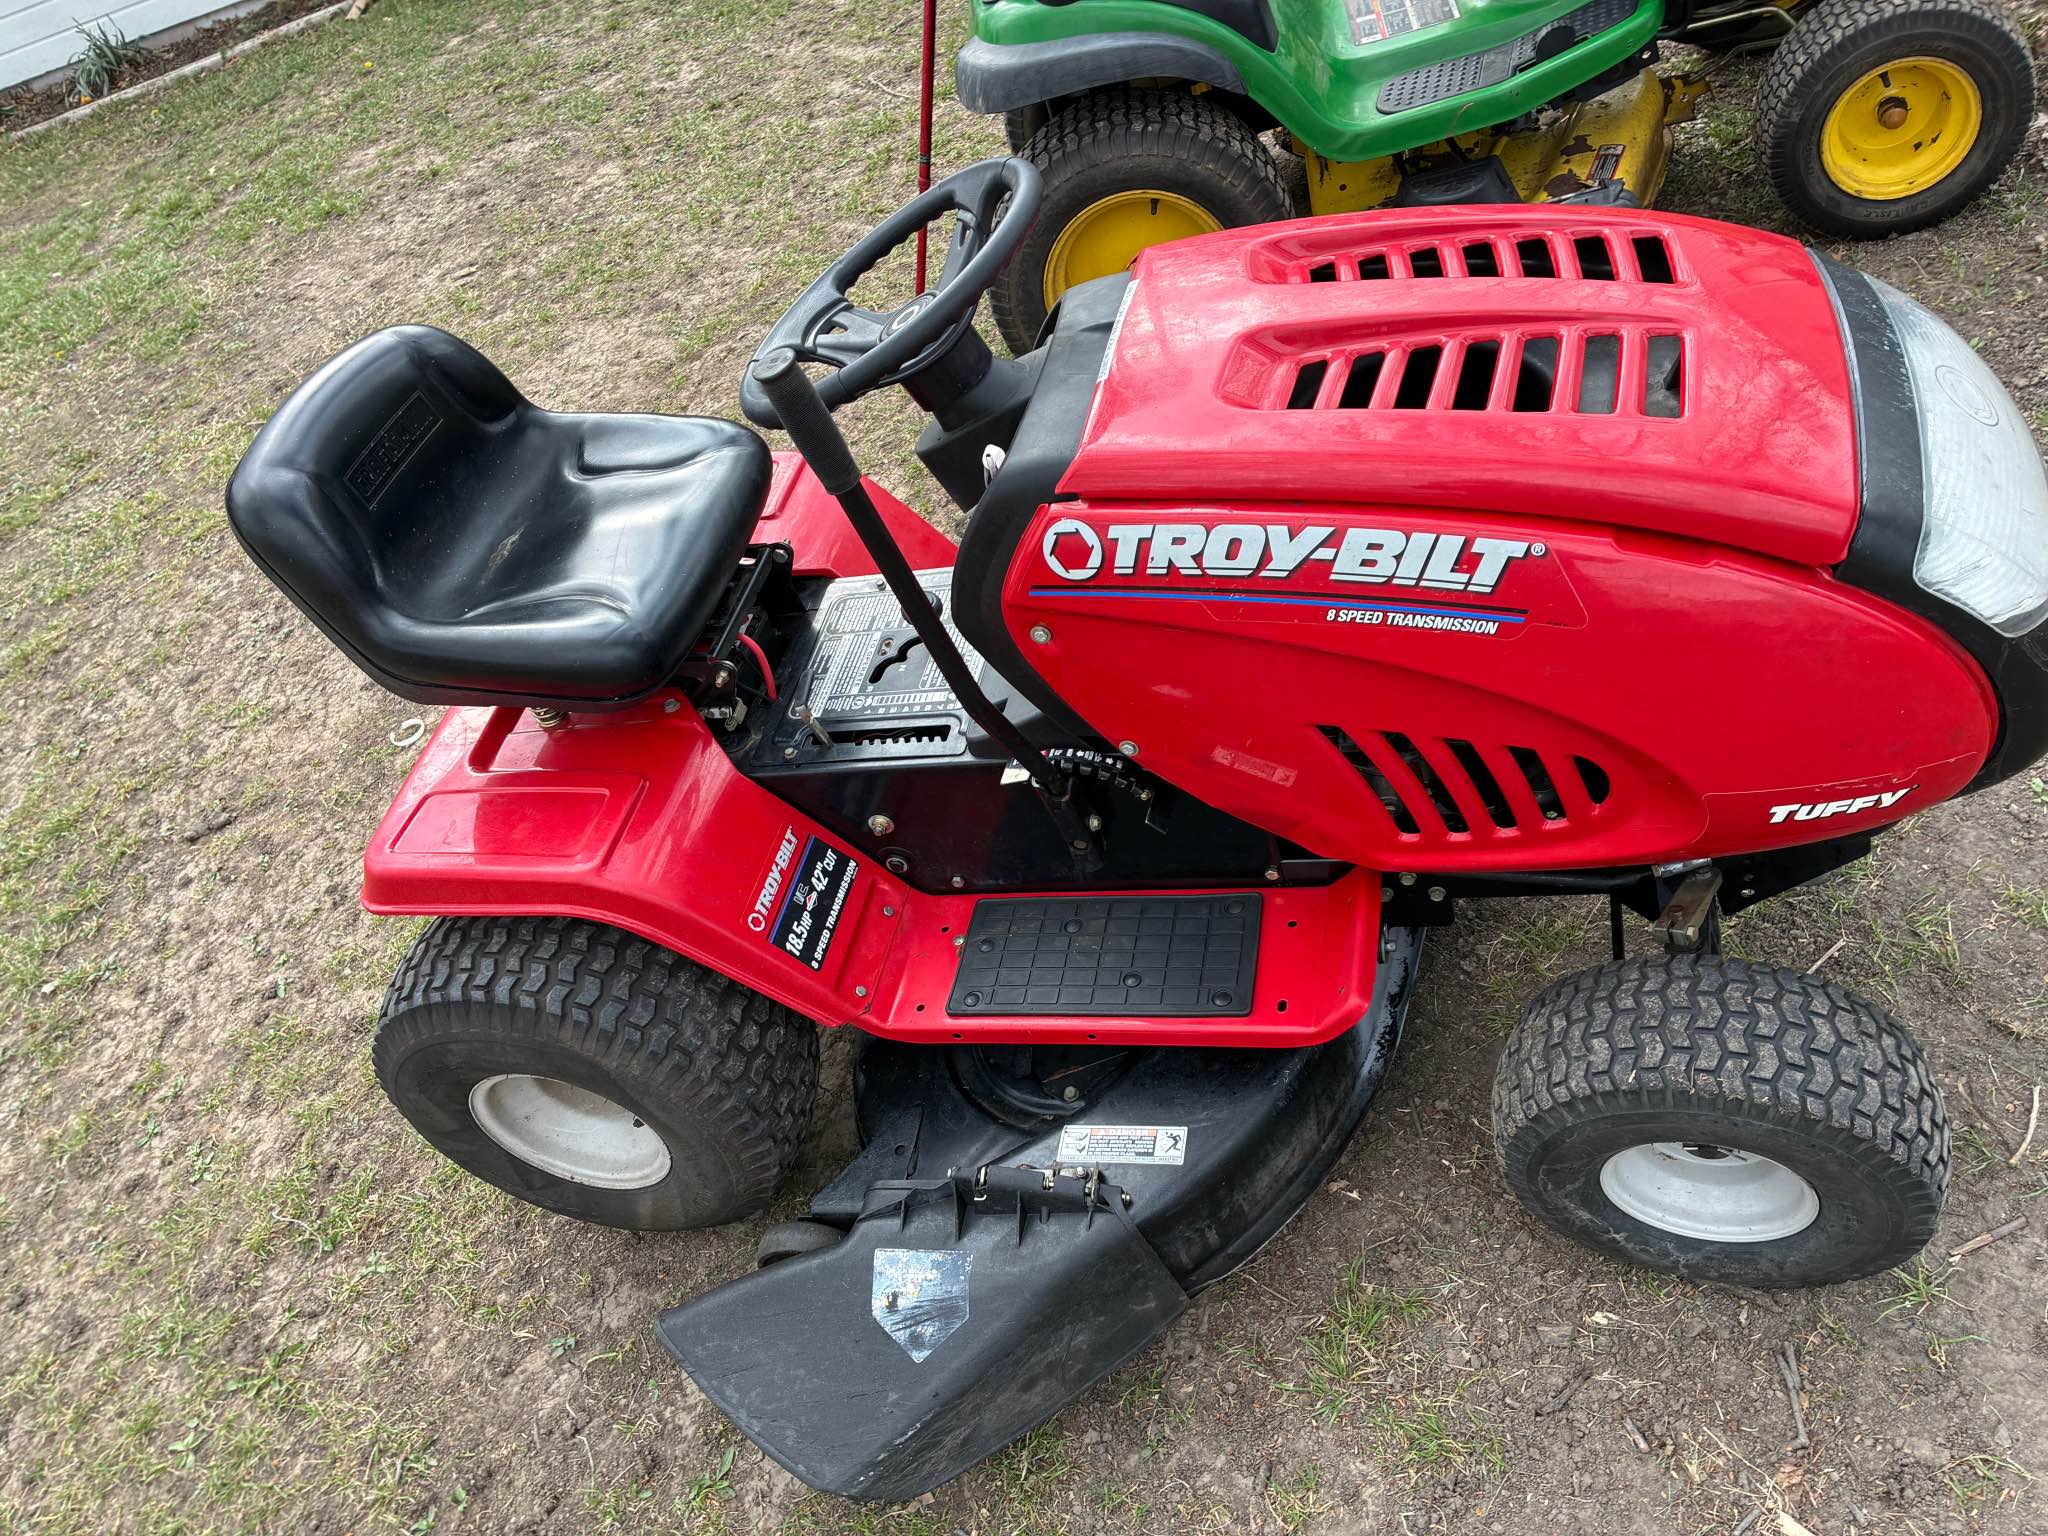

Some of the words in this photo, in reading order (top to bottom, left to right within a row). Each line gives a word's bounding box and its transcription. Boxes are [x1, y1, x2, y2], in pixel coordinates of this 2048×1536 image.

[1326, 609, 1337, 622] 8
[1338, 610, 1383, 625] SPEED
[1386, 612, 1499, 635] TRANSMISSION
[1769, 788, 1911, 824] TUFFY
[754, 826, 798, 917] TROY-BILT
[823, 849, 838, 871] CUT
[825, 859, 857, 930] TRANSMISSION
[814, 929, 831, 961] SPEED
[811, 960, 819, 969] 8
